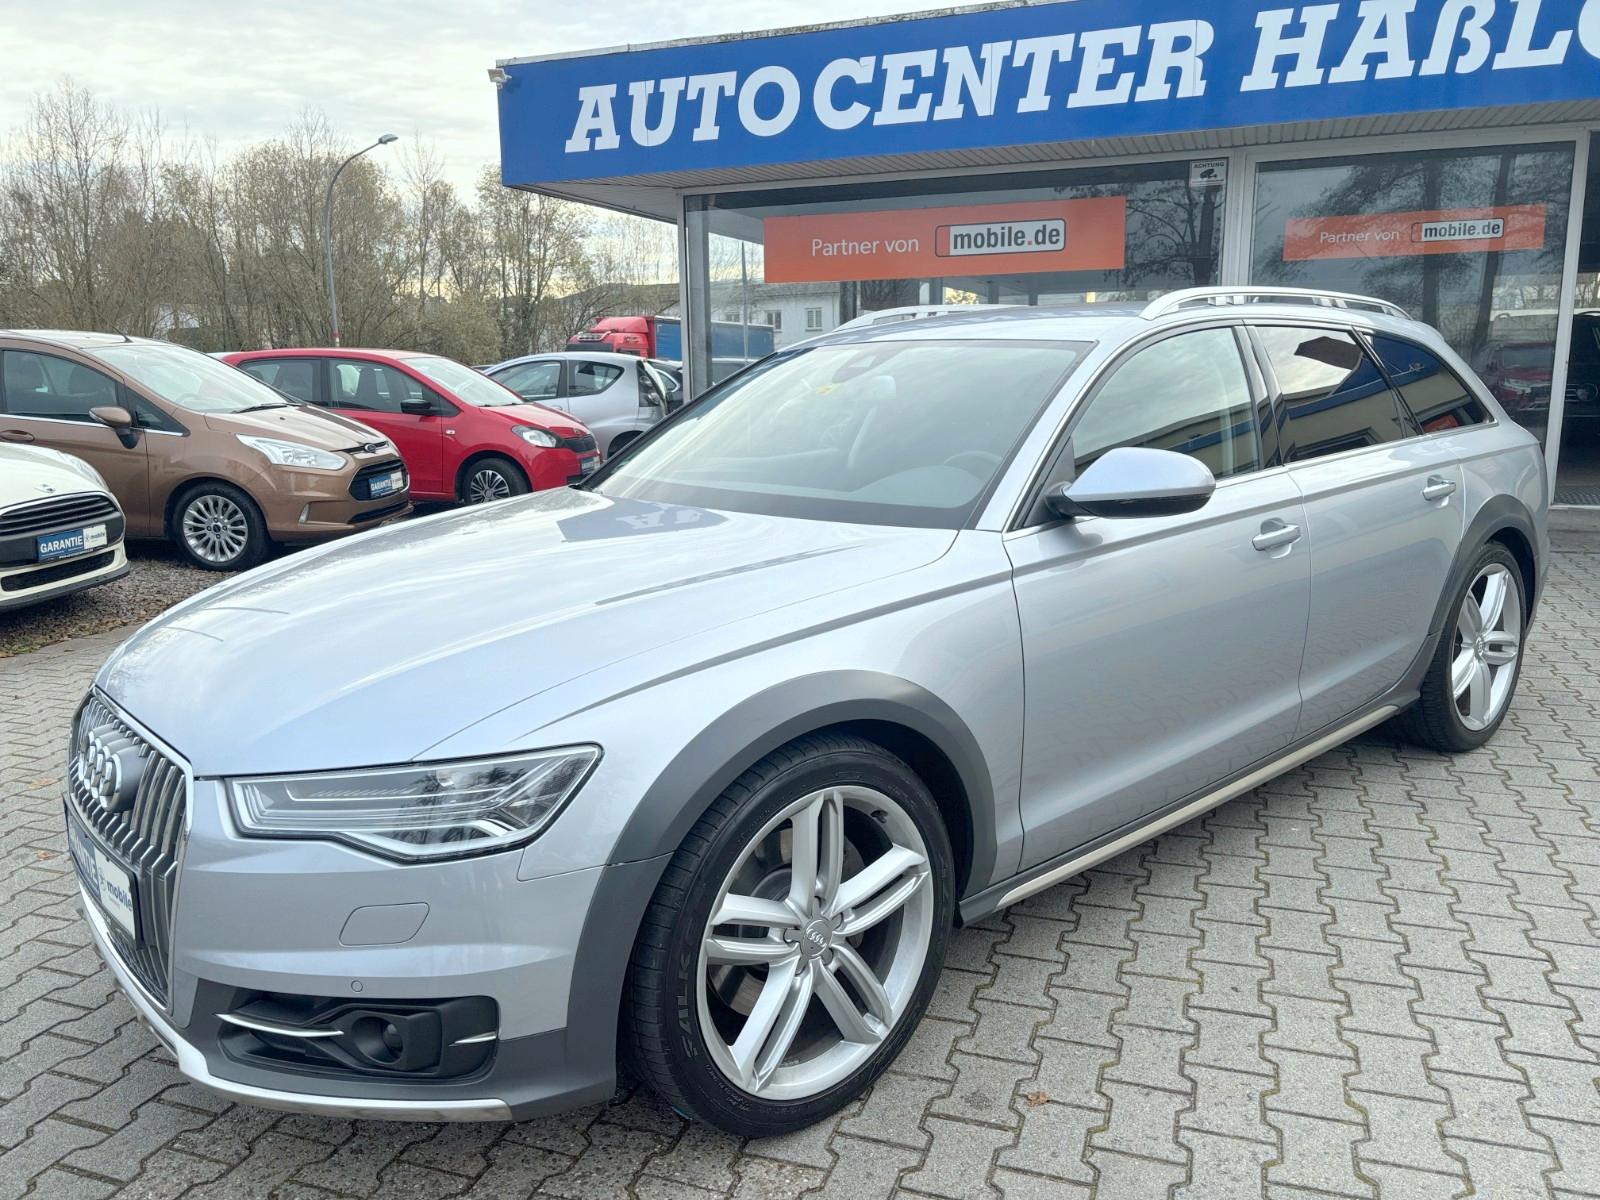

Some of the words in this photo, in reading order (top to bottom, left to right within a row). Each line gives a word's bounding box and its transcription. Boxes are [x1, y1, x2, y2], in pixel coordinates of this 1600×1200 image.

[812, 237, 880, 257] Partner
[884, 237, 919, 252] von
[953, 224, 1061, 250] mobile.de
[1319, 230, 1370, 244] Partner
[1375, 230, 1400, 241] von
[1423, 220, 1501, 238] mobile.de
[40, 535, 83, 553] GARANTIE
